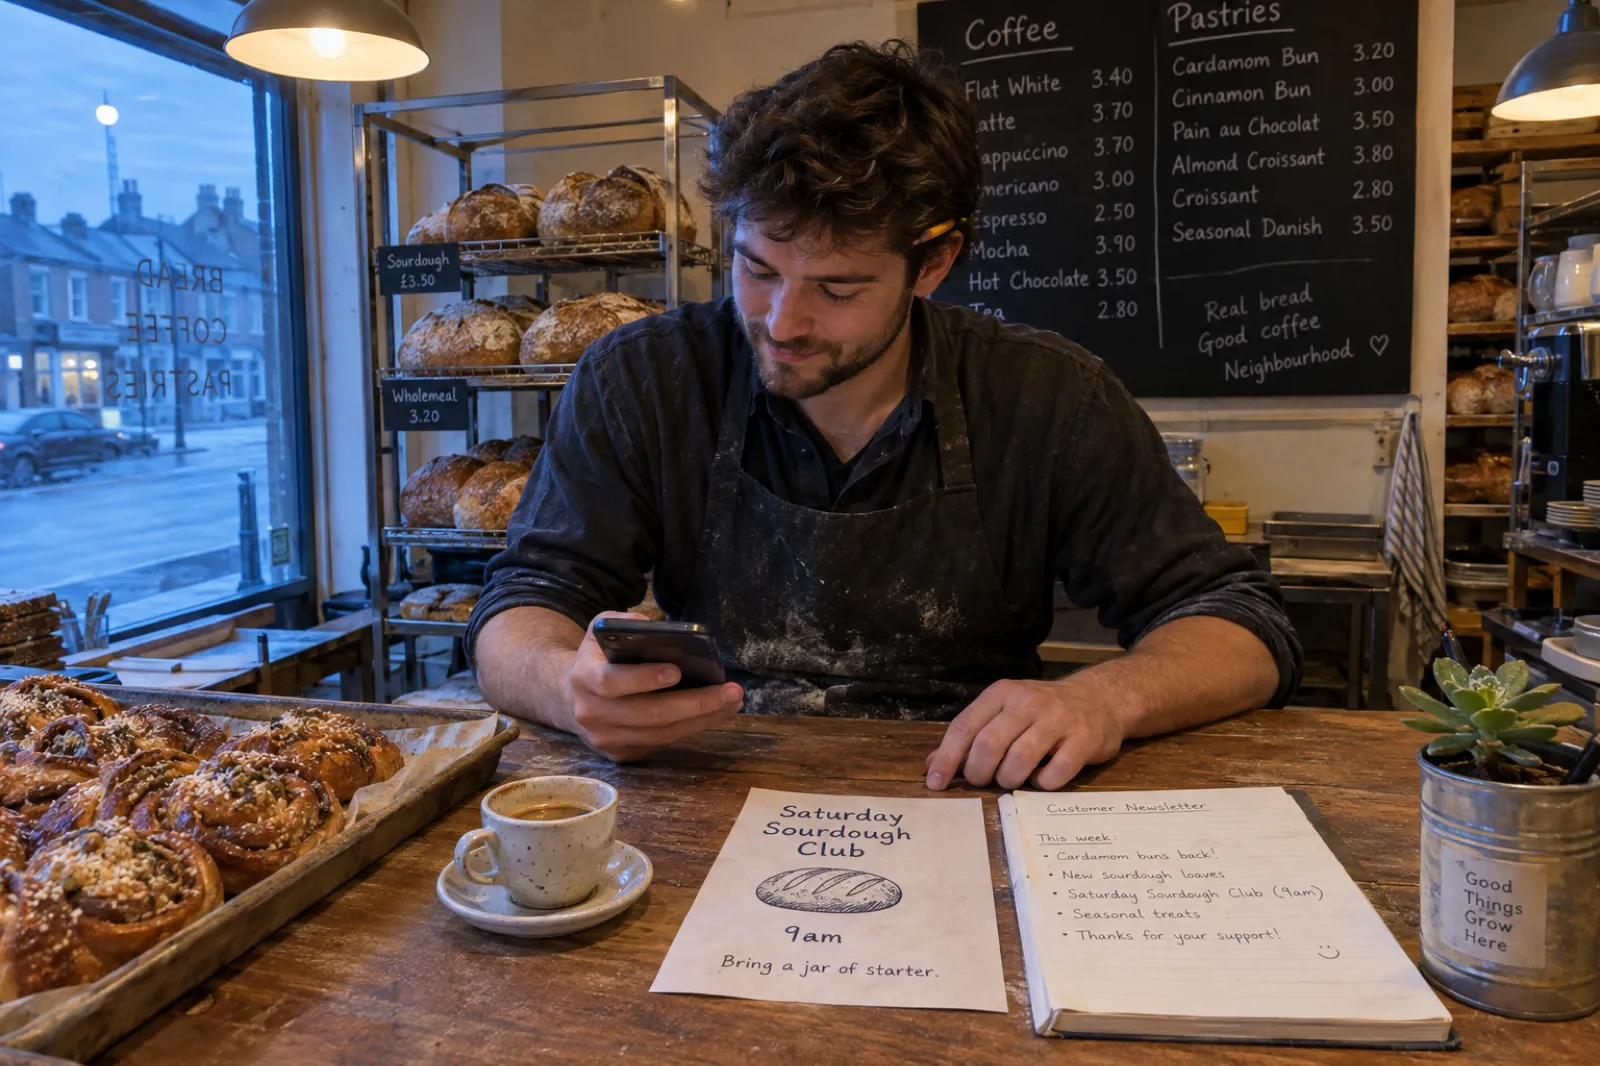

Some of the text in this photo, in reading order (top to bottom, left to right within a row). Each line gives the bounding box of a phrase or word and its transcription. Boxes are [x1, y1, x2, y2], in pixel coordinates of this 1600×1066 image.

[1167, 0, 1281, 33] Pastries
[965, 15, 1059, 50] Coffee
[1172, 42, 1395, 77] Cardamom Bun 3.20
[965, 67, 1133, 101] Flat White 3.40
[1172, 76, 1394, 108] Cinnamon Bun 3.00
[975, 101, 1133, 133] atte 3.70
[1172, 110, 1394, 141] Pain au Chocolat 3.50
[981, 136, 1134, 172] appuccino 3.70
[1171, 145, 1394, 176] Almond Croissant 3.80
[977, 170, 1134, 197] mericano 3.00
[1172, 180, 1393, 208] Croissant 2.80
[1094, 203, 1135, 223] 2.50
[1172, 215, 1393, 243] Seasonal Danish 3.50
[969, 235, 1136, 260] Mocha 3.90
[387, 251, 450, 273] Sourdough
[400, 274, 435, 289] £3.50
[969, 268, 1137, 292] Hot Chocolate 3.50
[1098, 301, 1138, 319] 2.80
[1204, 281, 1313, 323] Real bread
[1198, 314, 1321, 357] Good coffee
[1224, 337, 1355, 384] Neighbourhood
[392, 386, 458, 403] Wholemeal
[409, 409, 440, 424] 3.20
[780, 805, 903, 827] Saturday
[1046, 801, 1207, 814] Customer Newsletter
[762, 821, 912, 846] Sourdough
[1036, 832, 1118, 843] This week:
[797, 841, 865, 858] Club
[1056, 848, 1218, 861] Cardamom buns back!
[1062, 869, 1225, 884] New sourdough loaves
[1465, 871, 1513, 894] Good
[1068, 884, 1324, 904] Saturday Sourdough Club (9am)
[1464, 889, 1523, 917] Things
[1073, 908, 1201, 919] Seasonal treats
[1465, 910, 1513, 933] Grow
[784, 925, 842, 944] 9am
[1076, 927, 1282, 946] Thanks for your support!
[1465, 928, 1507, 952] Here
[721, 955, 939, 978] Bring a jar of starter.
